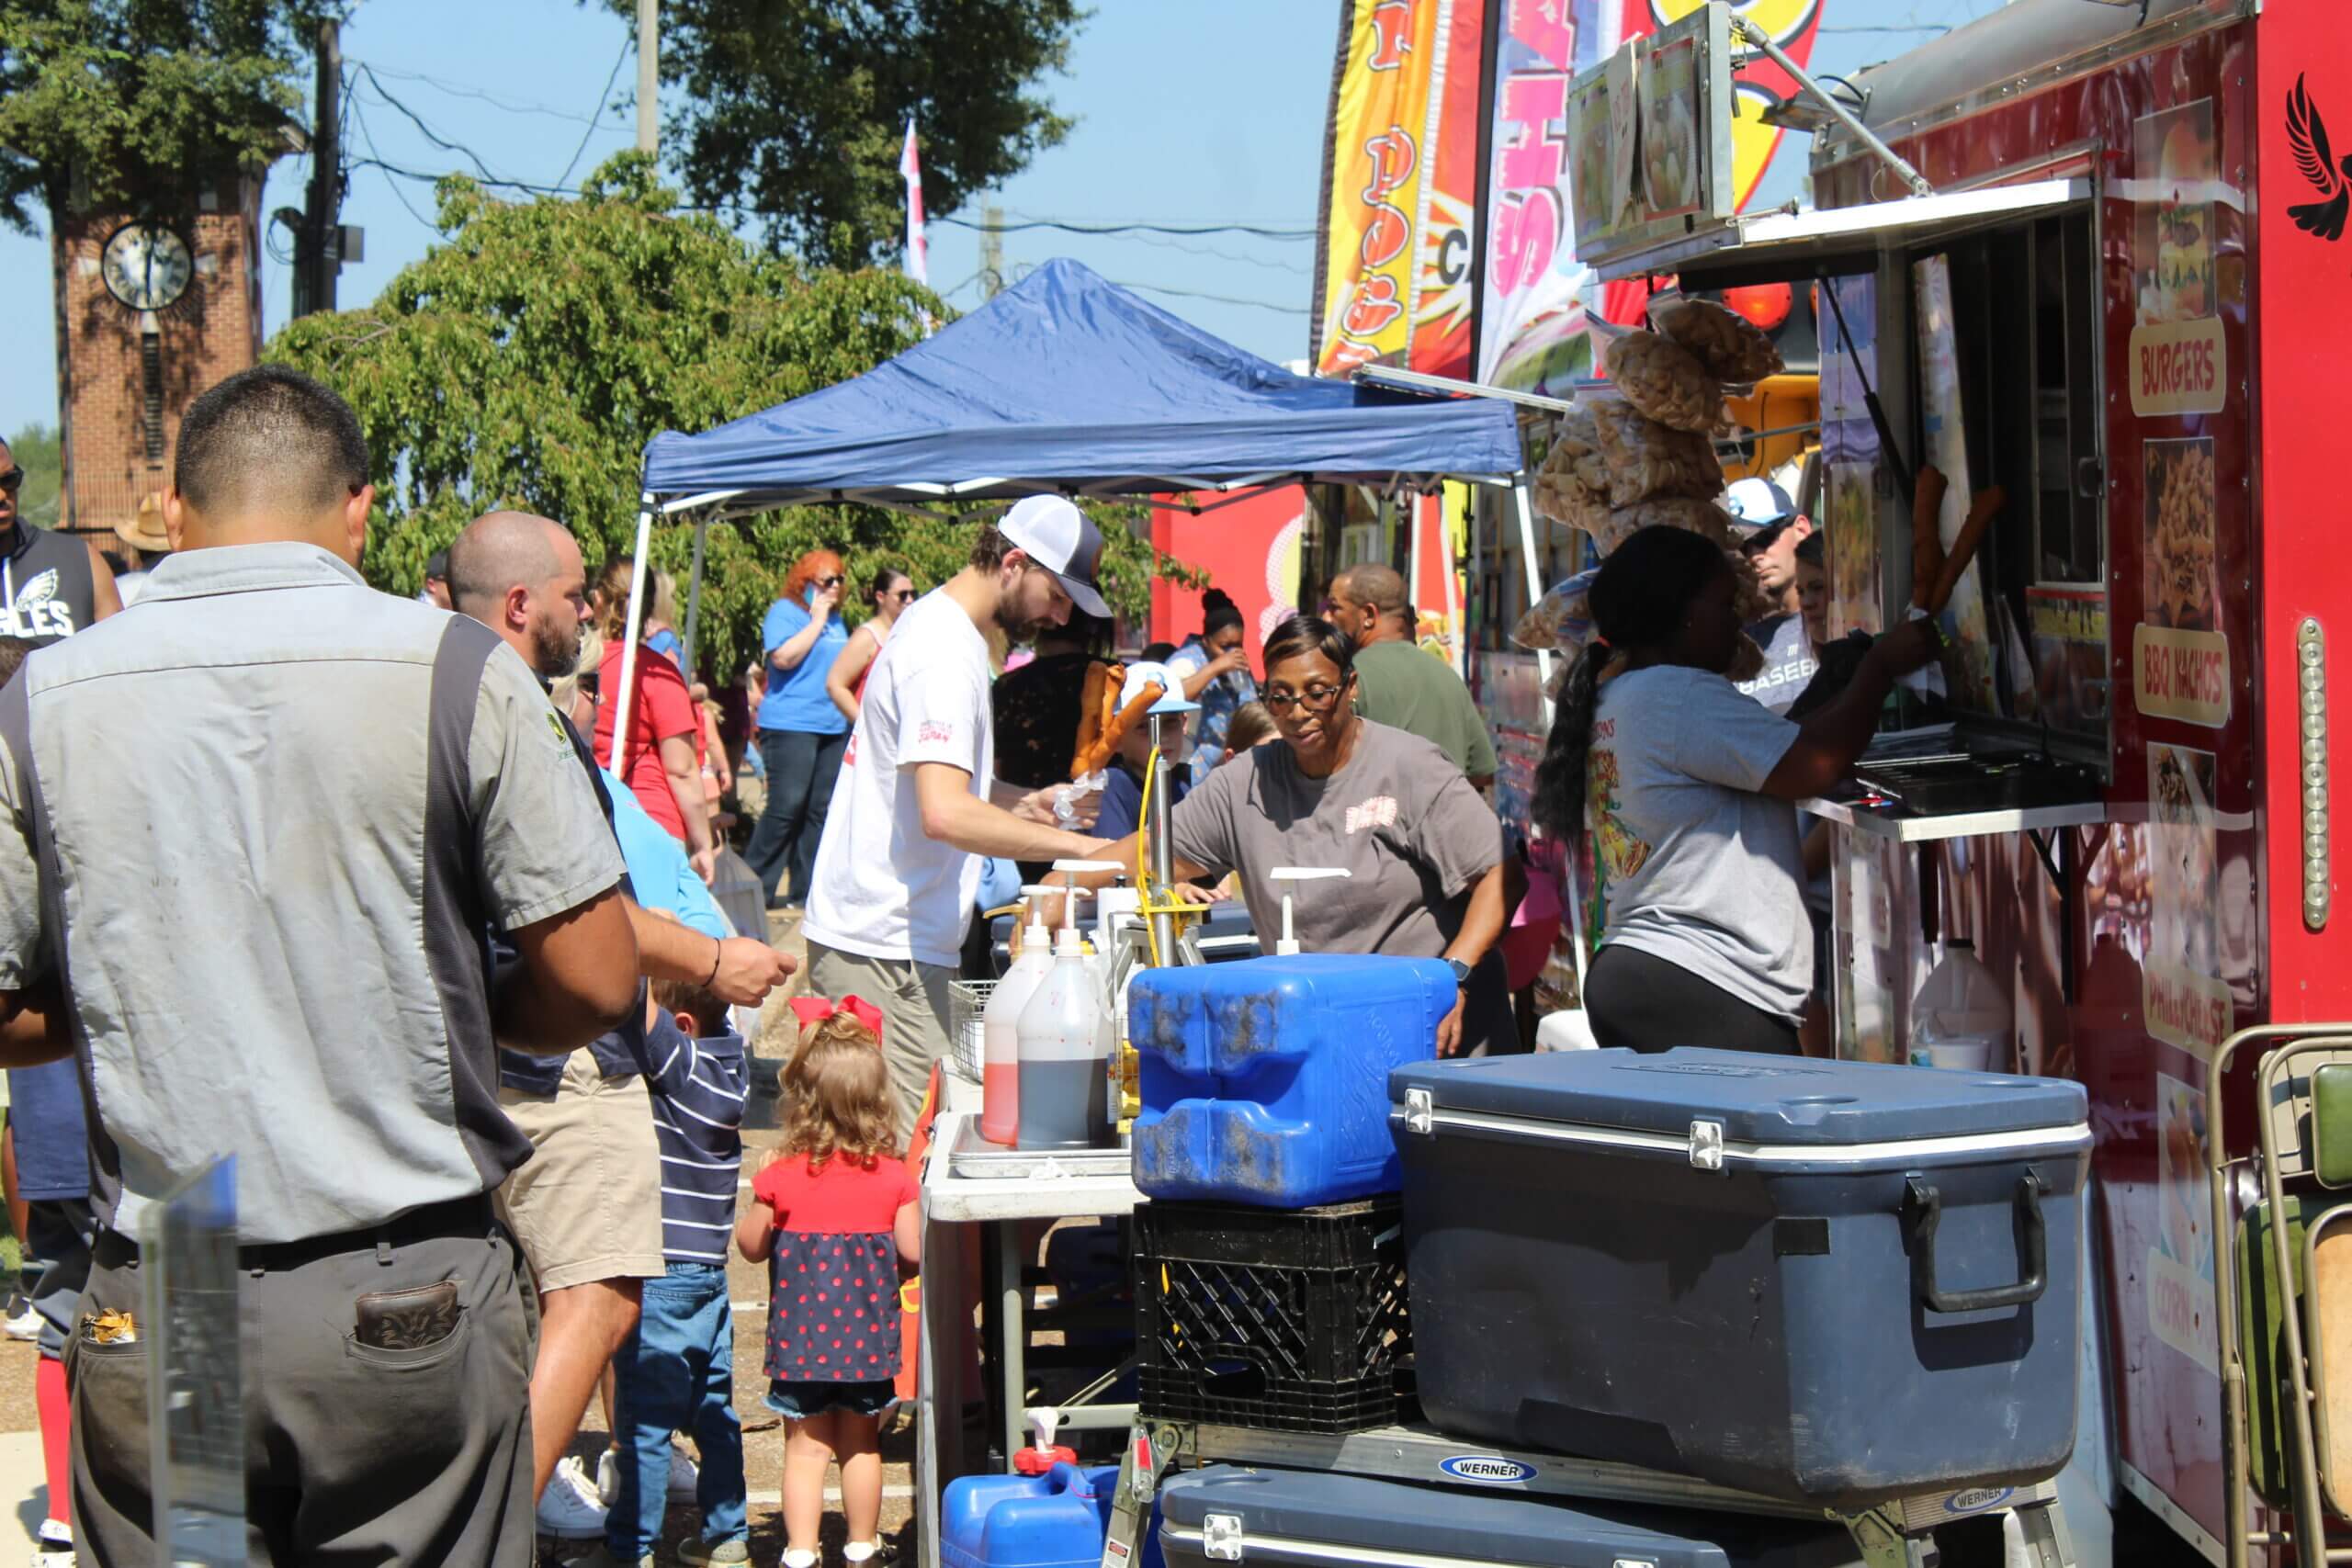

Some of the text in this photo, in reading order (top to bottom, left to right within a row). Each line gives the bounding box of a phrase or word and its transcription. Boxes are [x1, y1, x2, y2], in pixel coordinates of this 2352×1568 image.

[2141, 338, 2215, 397] BURGERS
[2144, 644, 2222, 705] BBQ NACHOS
[1460, 1461, 1519, 1476] WERNER
[1957, 1484, 2001, 1507] WERNER
